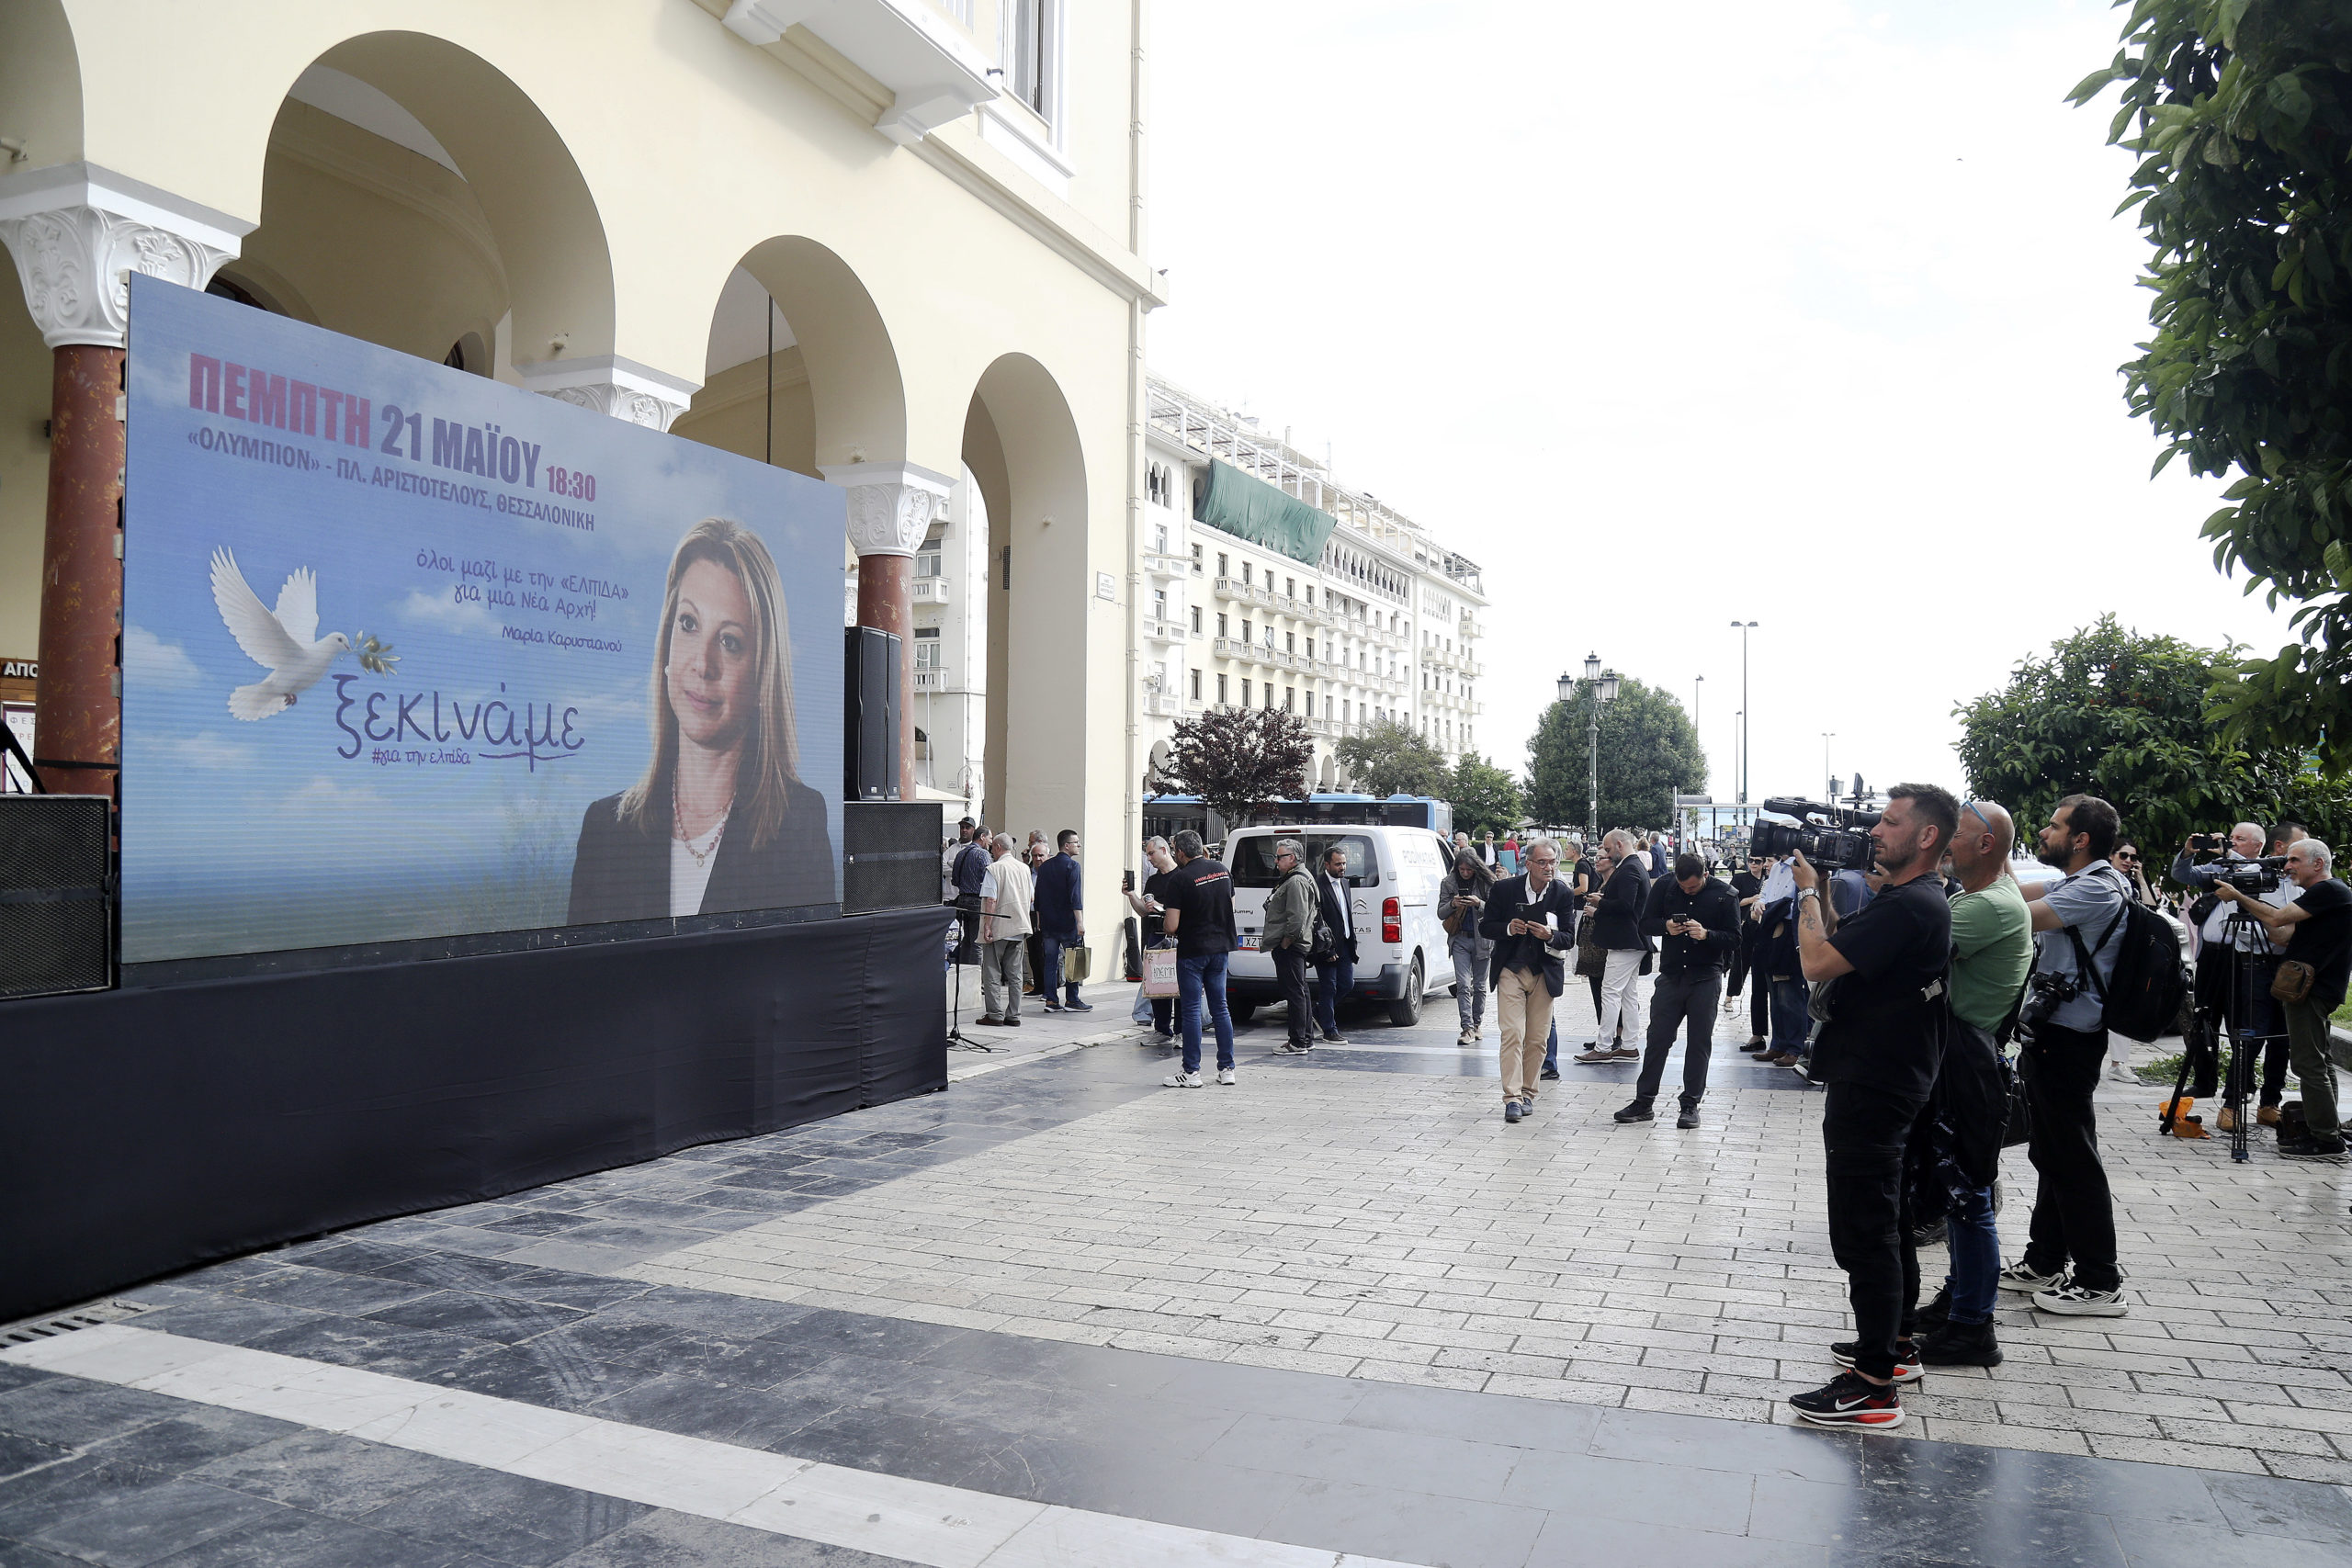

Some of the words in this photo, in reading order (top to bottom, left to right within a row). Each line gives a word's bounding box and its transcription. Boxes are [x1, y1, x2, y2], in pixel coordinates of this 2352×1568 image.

[189, 353, 370, 449] ΠΕΜΠΤΗ
[380, 404, 422, 462] 21
[433, 417, 541, 489] ΜΑΪΟΥ
[546, 465, 596, 502] 18:30
[187, 427, 320, 471] «ΟΛΥΜΠΙΟΝ»
[337, 458, 367, 483] ΠΛ.
[371, 467, 492, 513] ΑΡΙΣΤΟΤΕΛΟΥΣ,
[496, 496, 595, 532] ΘΕΣΣΑΛΟΝΙΚΗ
[416, 548, 455, 572] όλοι
[461, 559, 498, 581] μαζί
[503, 568, 523, 586] με
[529, 571, 554, 592] την
[561, 575, 629, 600] «ΕΛΠΙΔΑ»
[454, 583, 481, 604] για
[487, 590, 515, 610] μια
[521, 592, 549, 612] Νέα
[555, 599, 596, 621] Αρχή!
[332, 673, 584, 773] ξεκινάμε
[405, 750, 426, 765] την
[430, 747, 470, 764] ελπίδα
